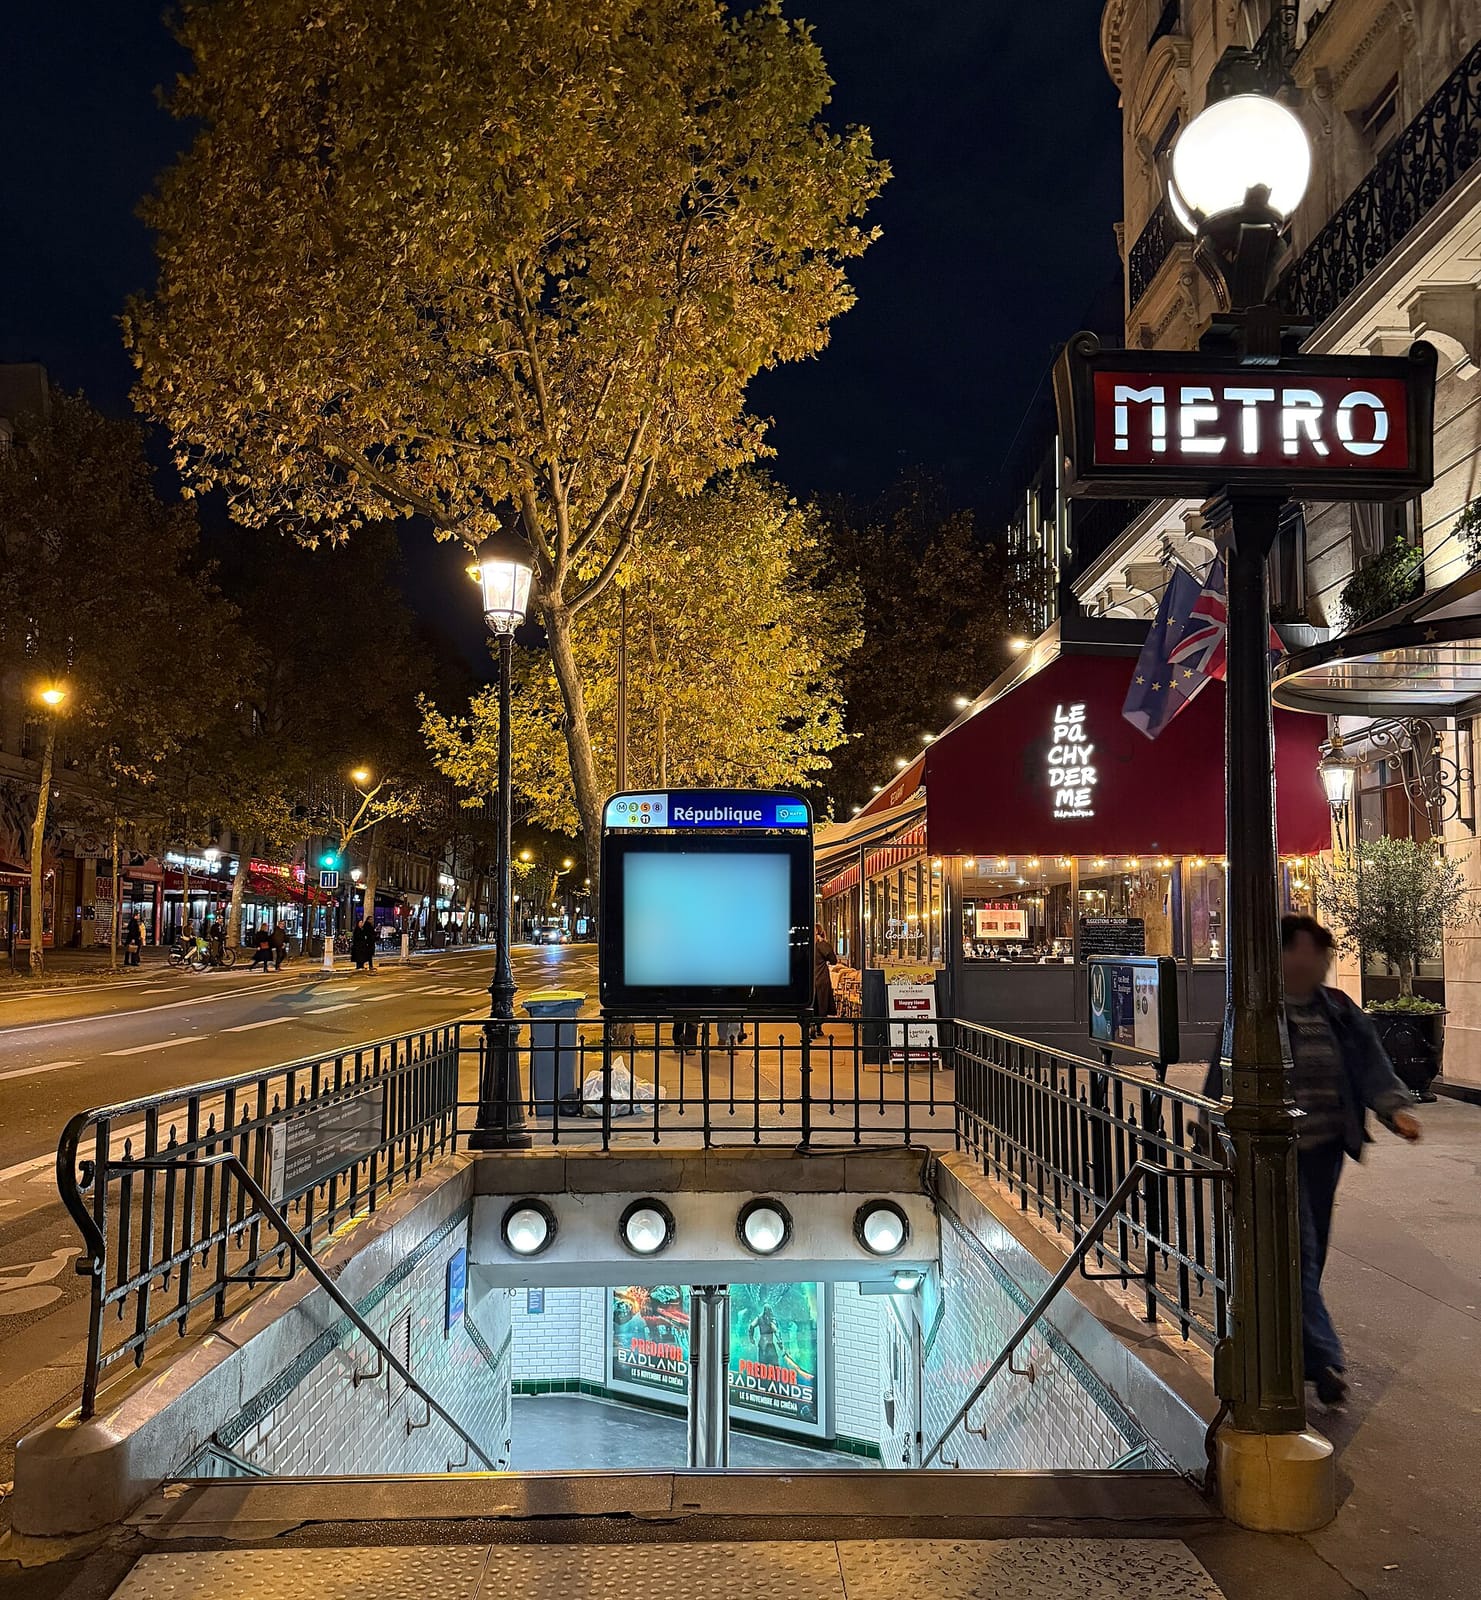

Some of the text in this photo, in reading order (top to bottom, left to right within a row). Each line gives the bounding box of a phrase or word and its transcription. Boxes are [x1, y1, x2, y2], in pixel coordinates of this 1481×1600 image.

[1114, 385, 1389, 456] METRO
[1054, 704, 1086, 724] LE
[1047, 744, 1094, 765] CHY
[1048, 767, 1097, 787] DER
[1055, 788, 1092, 808] ME
[674, 807, 762, 824] République
[984, 902, 1018, 910] MENU
[631, 1337, 683, 1361] PREDATOR
[618, 1350, 687, 1374] BADLAND
[631, 1368, 636, 1376] LE
[738, 1358, 797, 1385] PREDATOR
[728, 1372, 813, 1401] BADLANDS
[739, 1391, 745, 1400] LE
